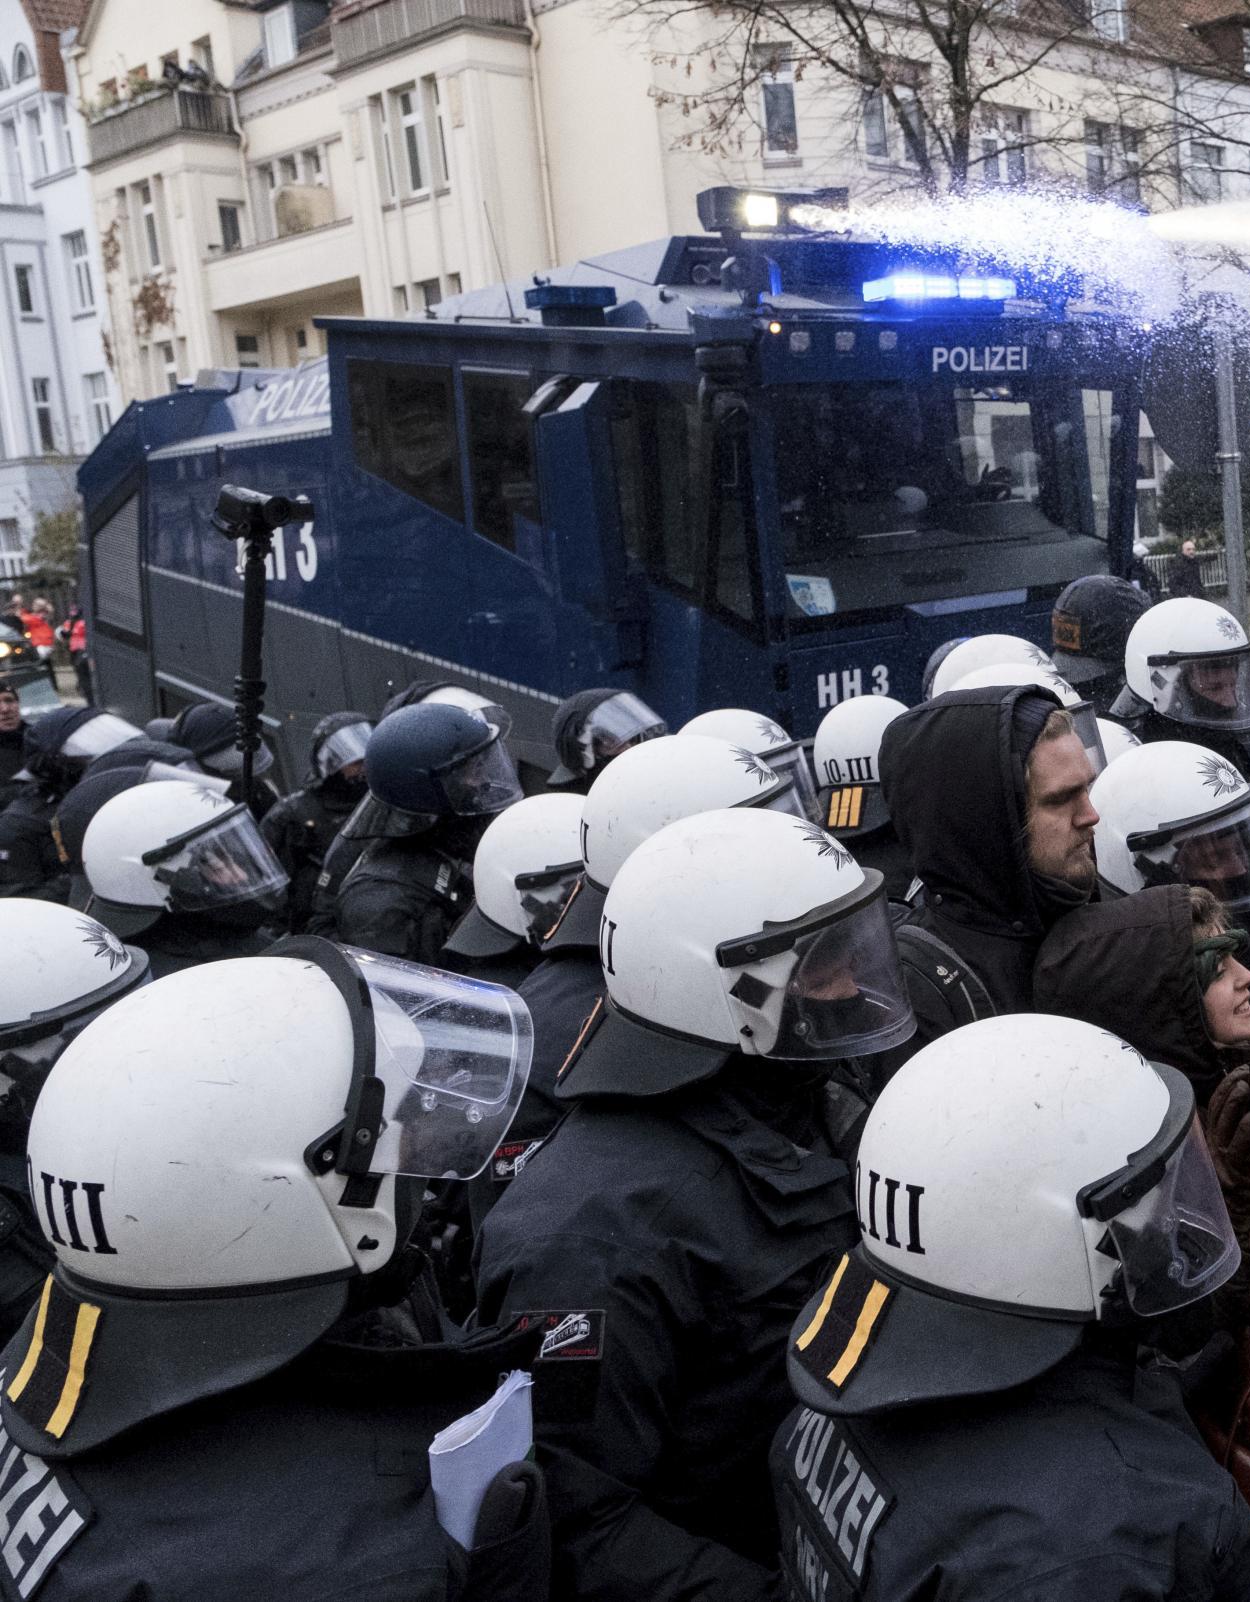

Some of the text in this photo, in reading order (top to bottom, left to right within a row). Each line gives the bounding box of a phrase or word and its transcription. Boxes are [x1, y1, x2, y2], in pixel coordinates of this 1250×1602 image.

[932, 345, 1028, 373] POLIZEI
[296, 494, 318, 583] 3
[816, 663, 890, 709] HH 3
[785, 1407, 886, 1577] POLIZEI
